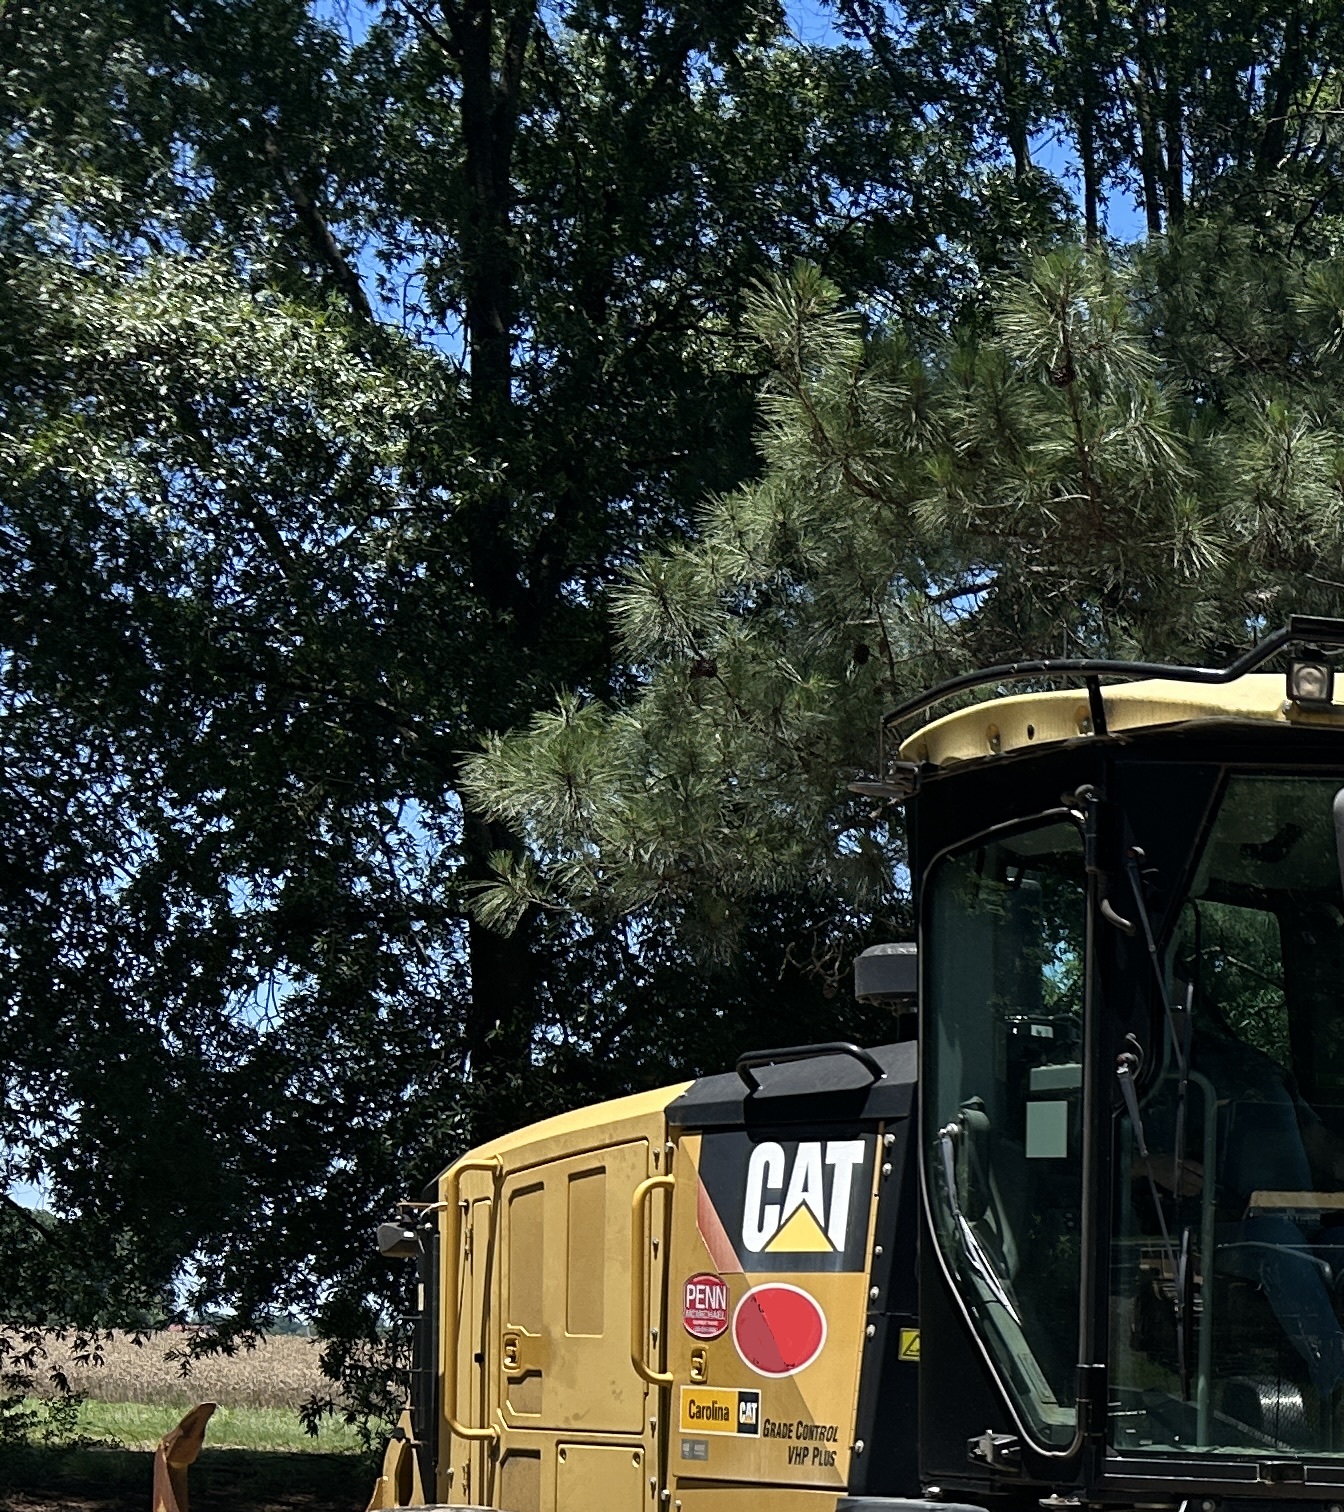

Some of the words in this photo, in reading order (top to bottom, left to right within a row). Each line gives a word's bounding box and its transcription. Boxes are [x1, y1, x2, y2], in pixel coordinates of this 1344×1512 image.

[742, 1140, 866, 1253] CAT
[686, 1284, 726, 1310] PENN
[688, 1399, 730, 1421] Carolina
[739, 1401, 758, 1425] CAT
[763, 1418, 794, 1440] GRADE
[795, 1420, 839, 1443] CONTROL
[788, 1445, 810, 1466] VHP
[811, 1446, 838, 1467] PLUS
